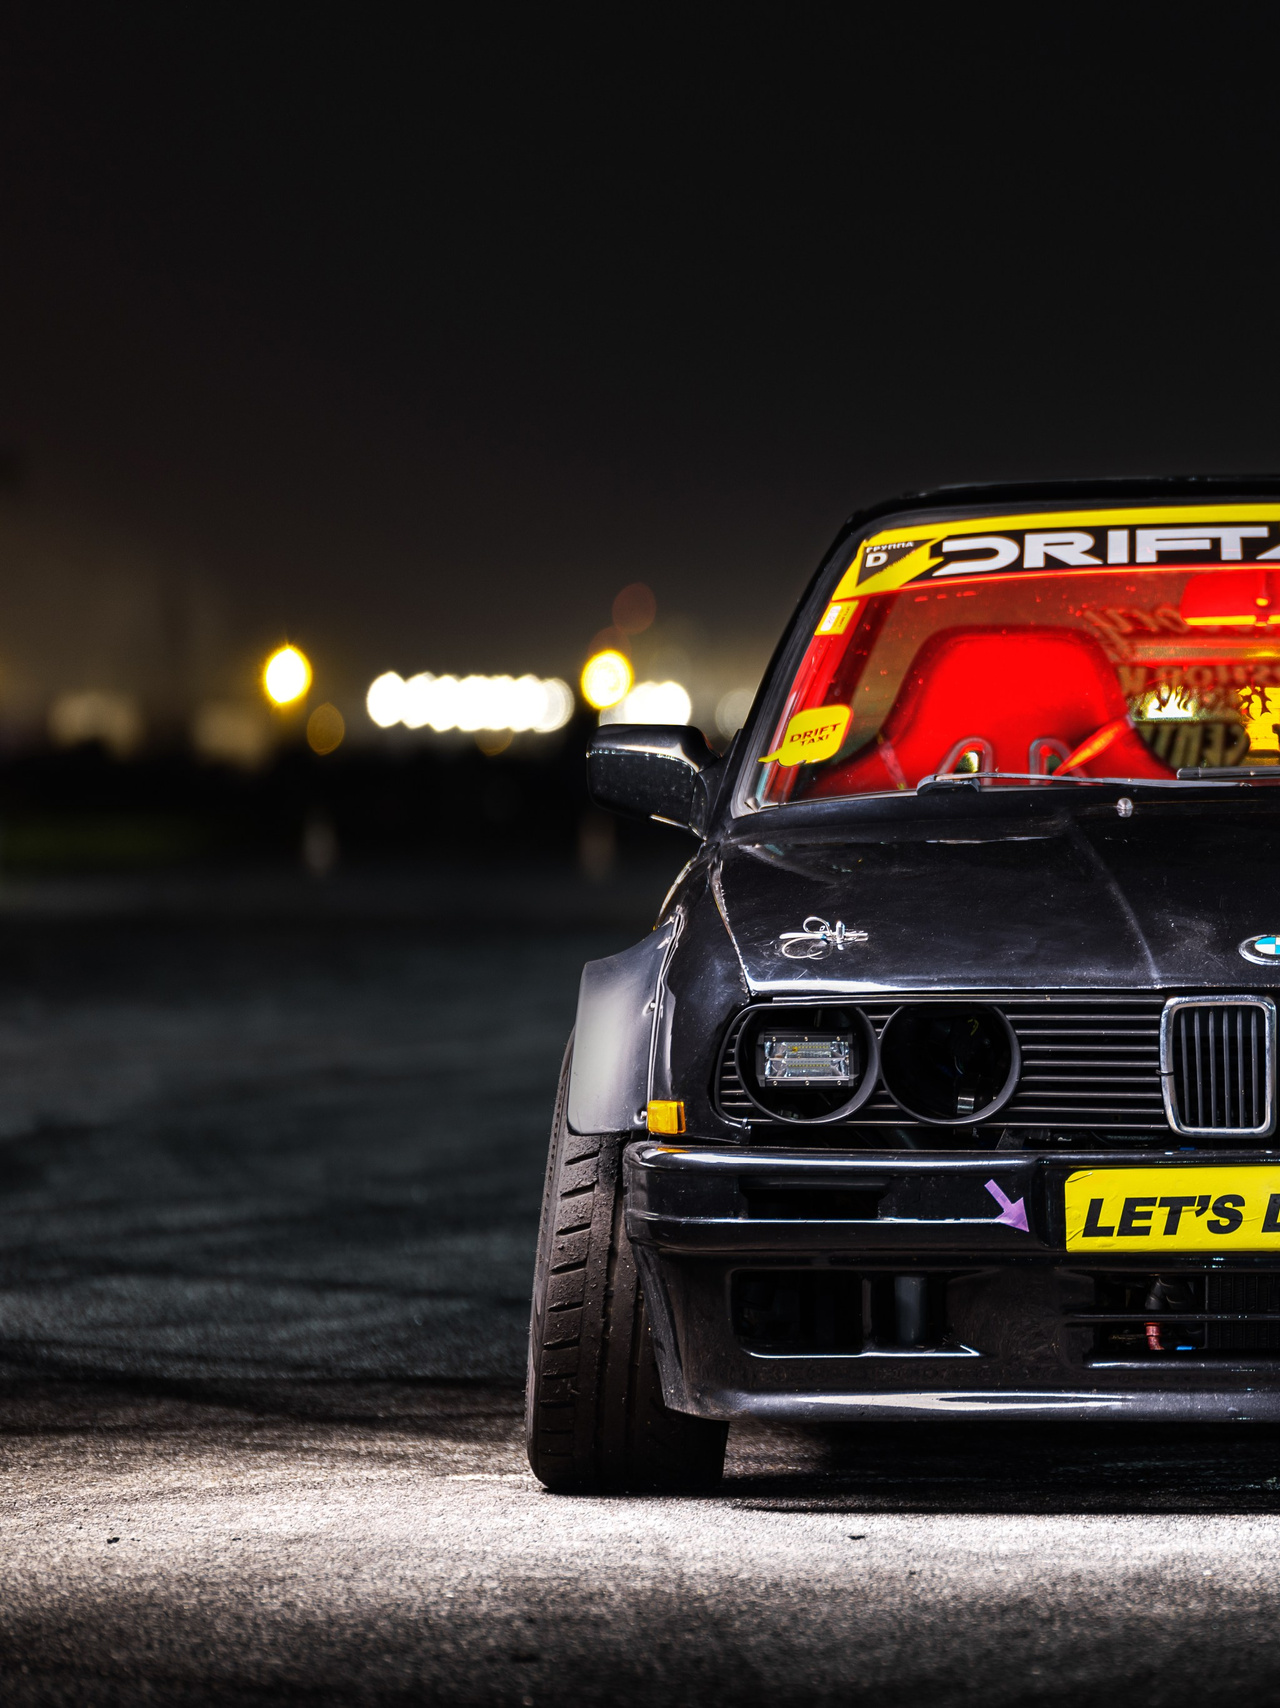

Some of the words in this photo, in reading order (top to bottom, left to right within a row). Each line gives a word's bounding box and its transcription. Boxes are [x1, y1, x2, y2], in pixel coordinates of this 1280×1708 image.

[866, 541, 914, 553] ГРУППА
[932, 526, 1270, 577] DRIFT
[865, 552, 888, 568] D
[789, 722, 841, 743] DRIFT
[800, 734, 830, 746] TAXI
[1082, 1194, 1246, 1238] LET'S
